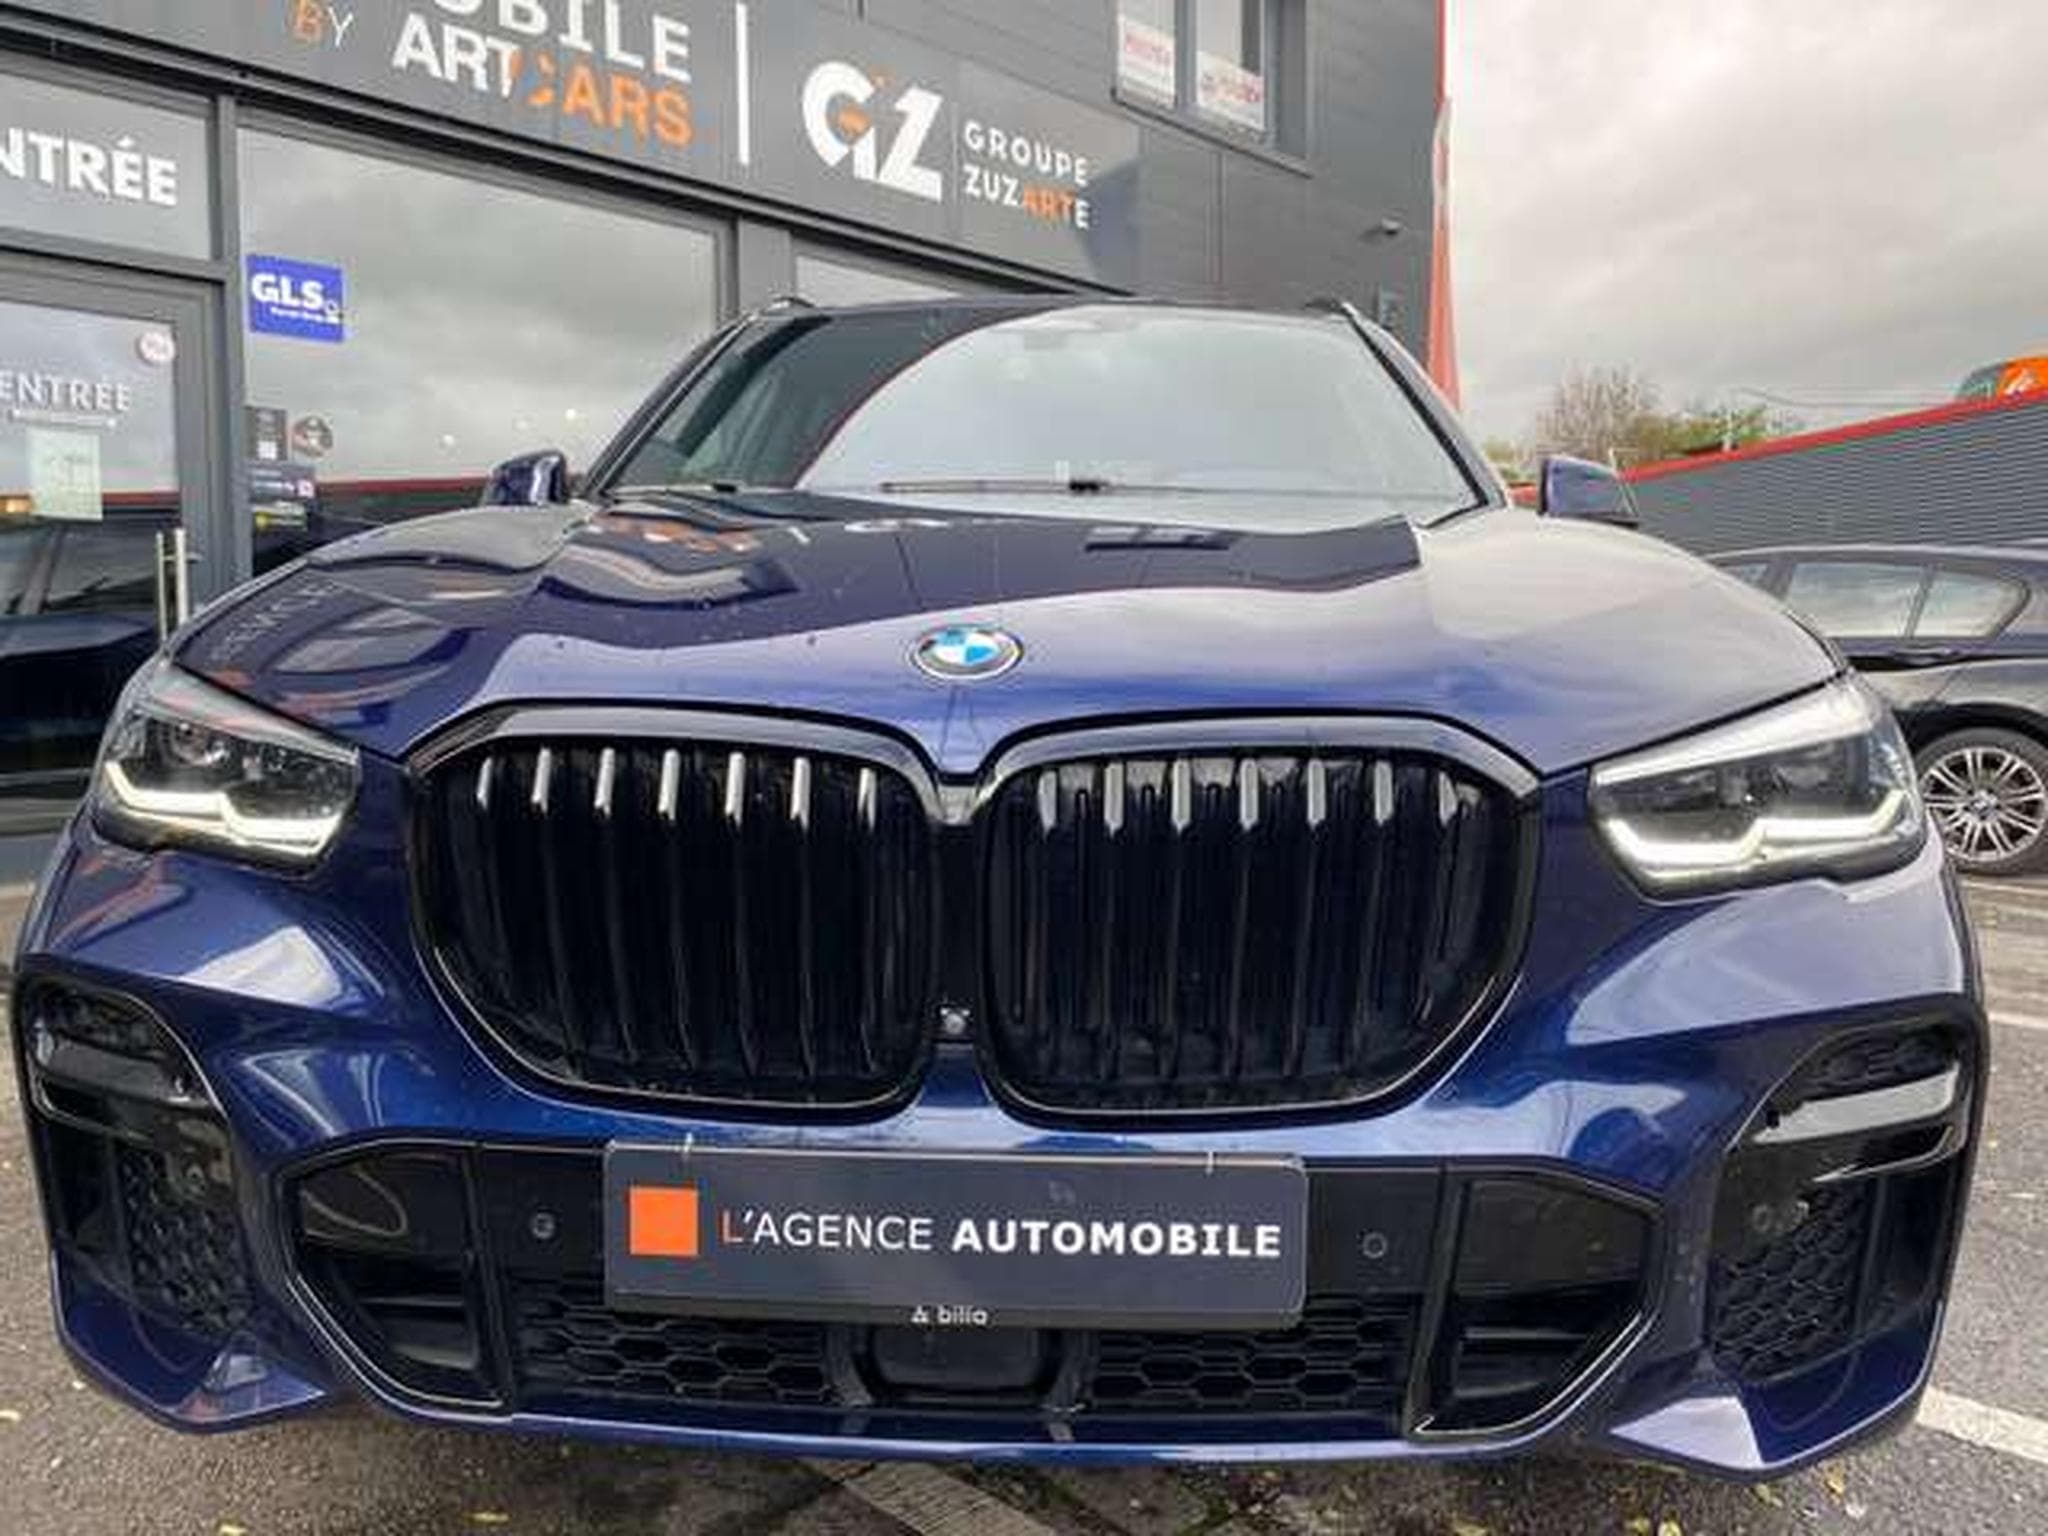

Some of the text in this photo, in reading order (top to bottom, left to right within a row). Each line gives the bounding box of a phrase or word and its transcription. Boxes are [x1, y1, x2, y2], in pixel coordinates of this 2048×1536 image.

[292, 0, 353, 48] BY
[432, 0, 692, 83] BILE
[964, 120, 1089, 188] GROUPE
[720, 1207, 1282, 1258] L'AGENCE AUTOMOBILE
